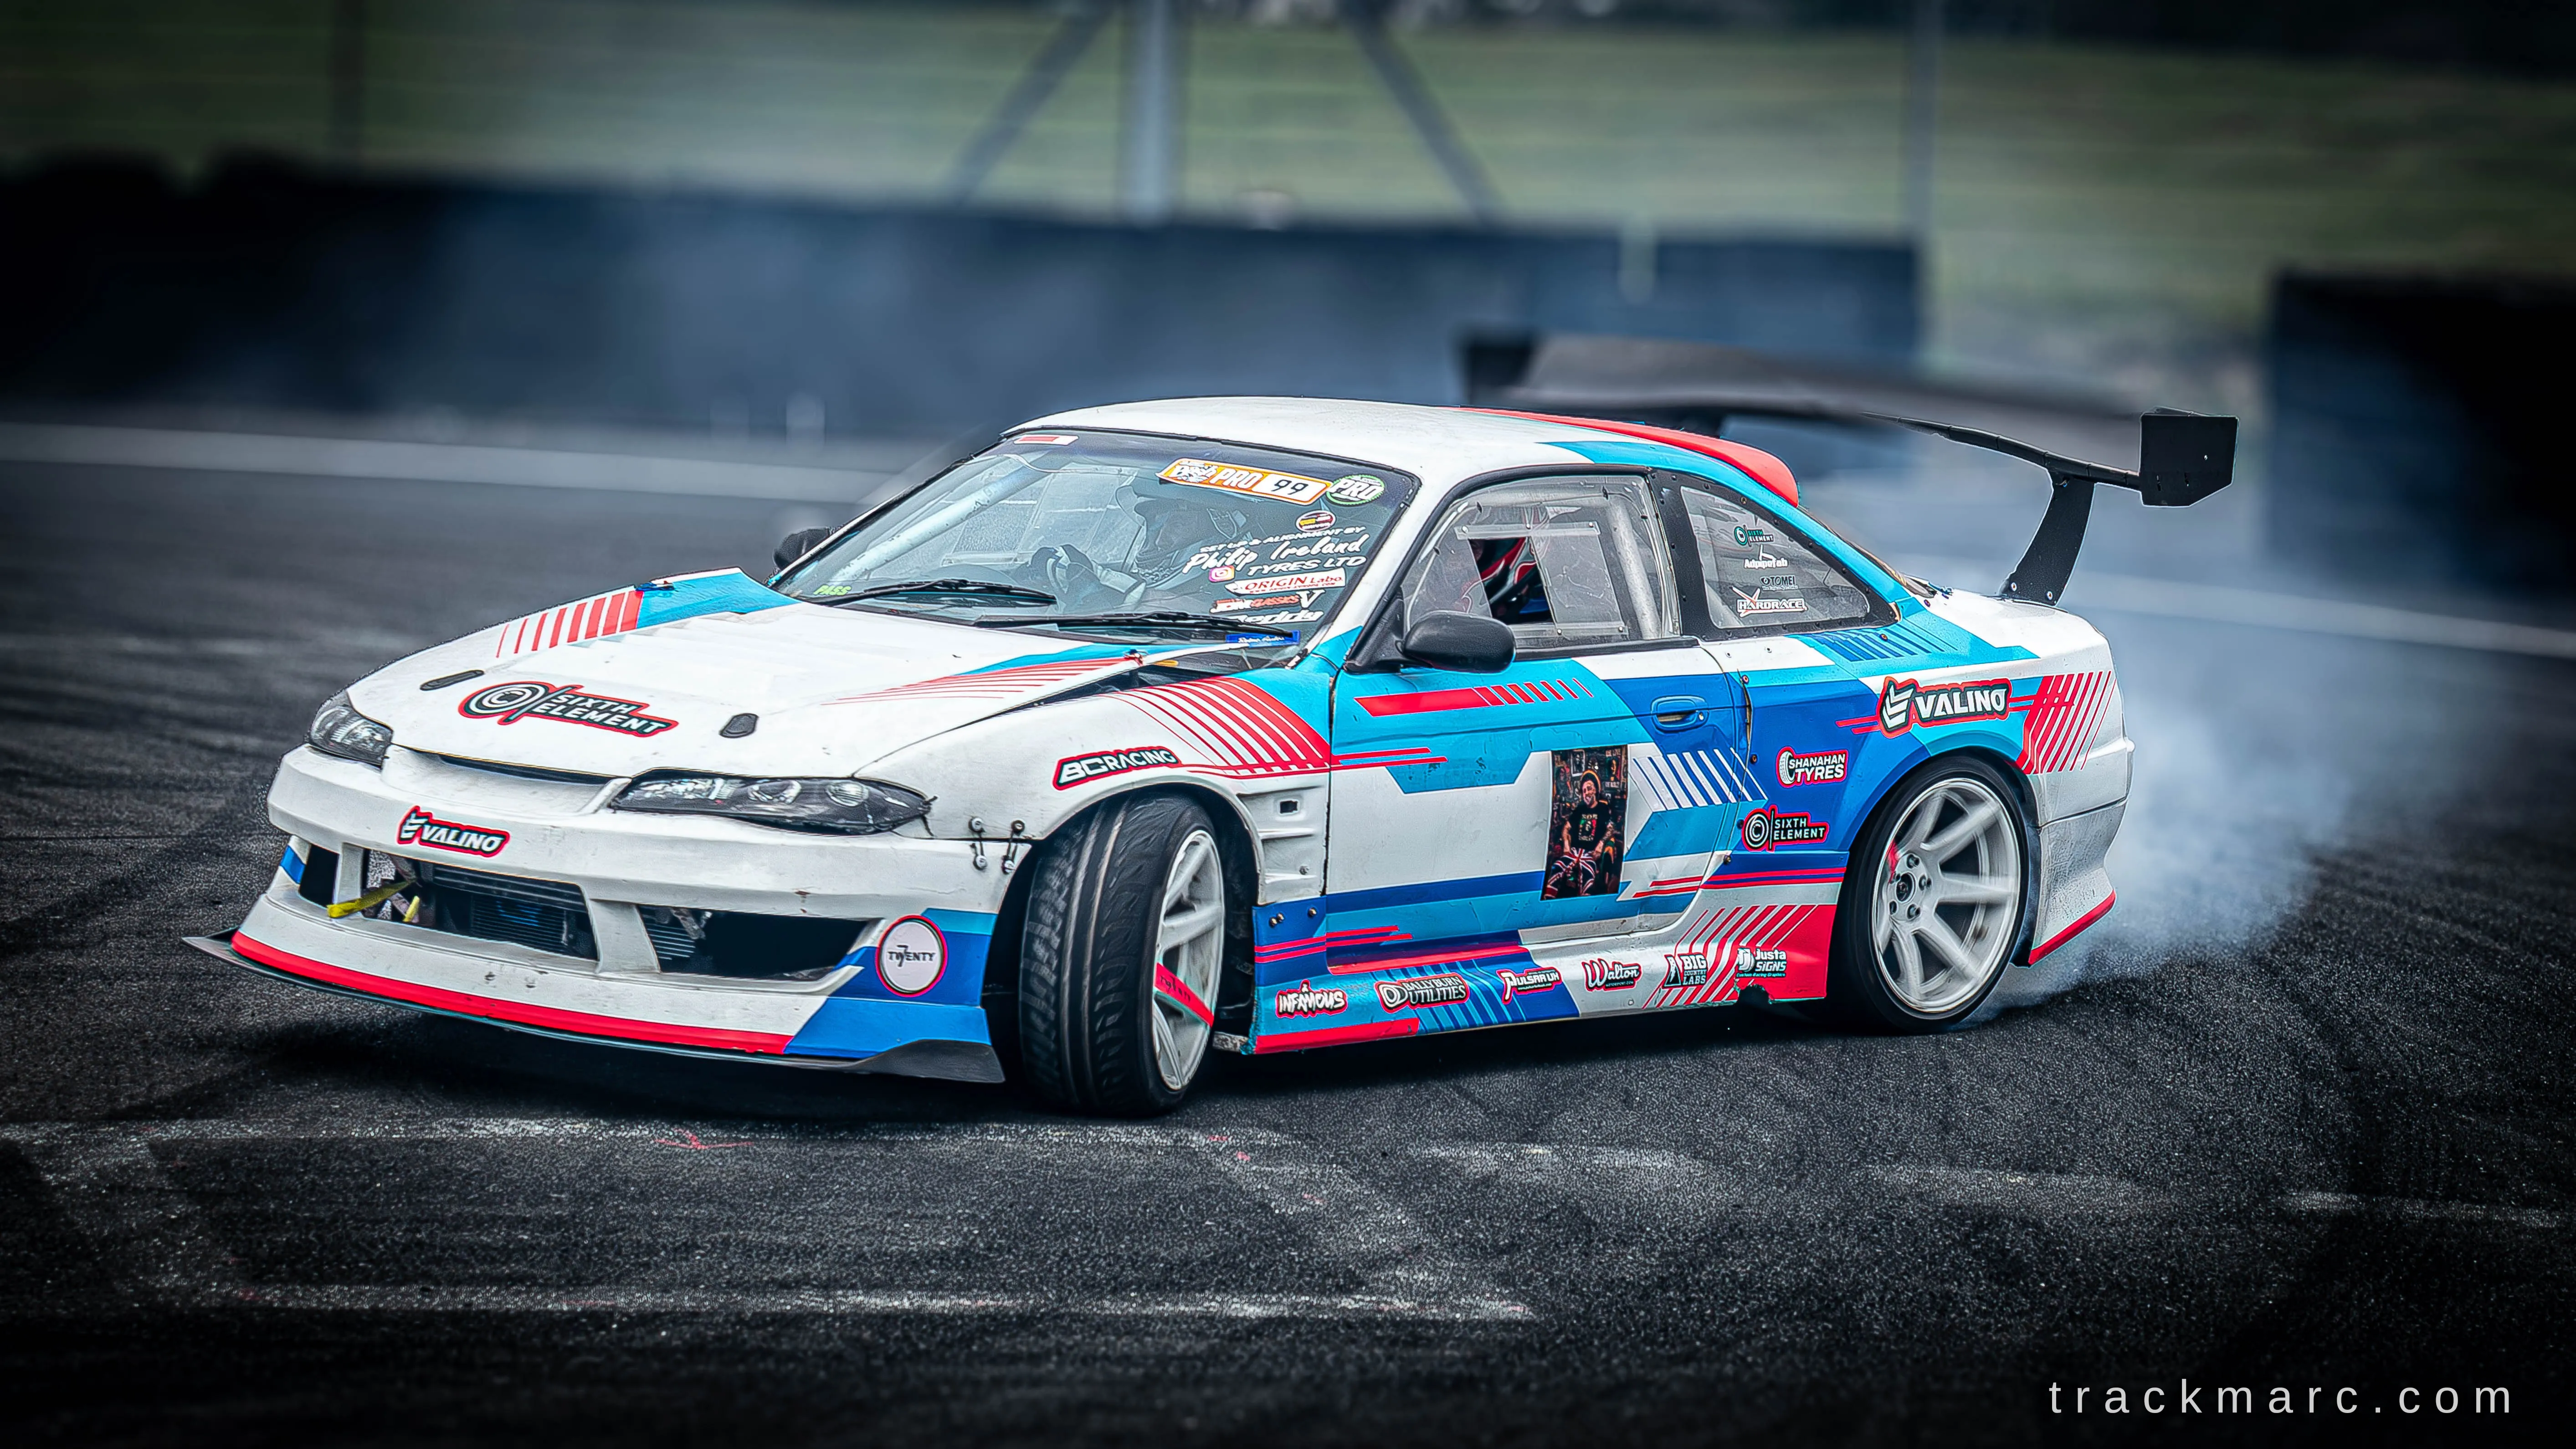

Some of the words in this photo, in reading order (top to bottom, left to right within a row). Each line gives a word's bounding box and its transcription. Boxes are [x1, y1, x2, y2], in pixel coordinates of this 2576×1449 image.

[1209, 468, 1263, 489] PRO
[1271, 479, 1309, 495] 99
[1329, 478, 1385, 500] PRO
[1182, 547, 1258, 573] Philip
[1270, 534, 1369, 560] Ireland
[1248, 560, 1321, 575] TYRES
[1324, 556, 1366, 567] LTD
[1245, 576, 1307, 590] ORIGIN
[1770, 576, 1796, 585] TOMEI
[813, 585, 852, 596] PASS
[1739, 600, 1803, 610] HARDRACE
[553, 694, 638, 714] SIXTH
[1915, 689, 2006, 718] VALINO
[538, 703, 667, 733] ELEMENT
[1789, 754, 1846, 769] SHANAHAN
[1795, 764, 1844, 782] TYRES
[1775, 818, 1806, 828] SIXTH
[421, 825, 505, 852] VALINO
[1774, 827, 1825, 840] ELEMENT
[1680, 955, 1706, 970] BIG
[1755, 948, 1786, 960] Justa
[1585, 960, 1639, 987] Walton
[1683, 975, 1706, 985] LABS
[1402, 976, 1463, 991] BALLYBURN
[1279, 991, 1344, 1013] INFAMOUS
[1409, 985, 1466, 1004] UTILITIES
